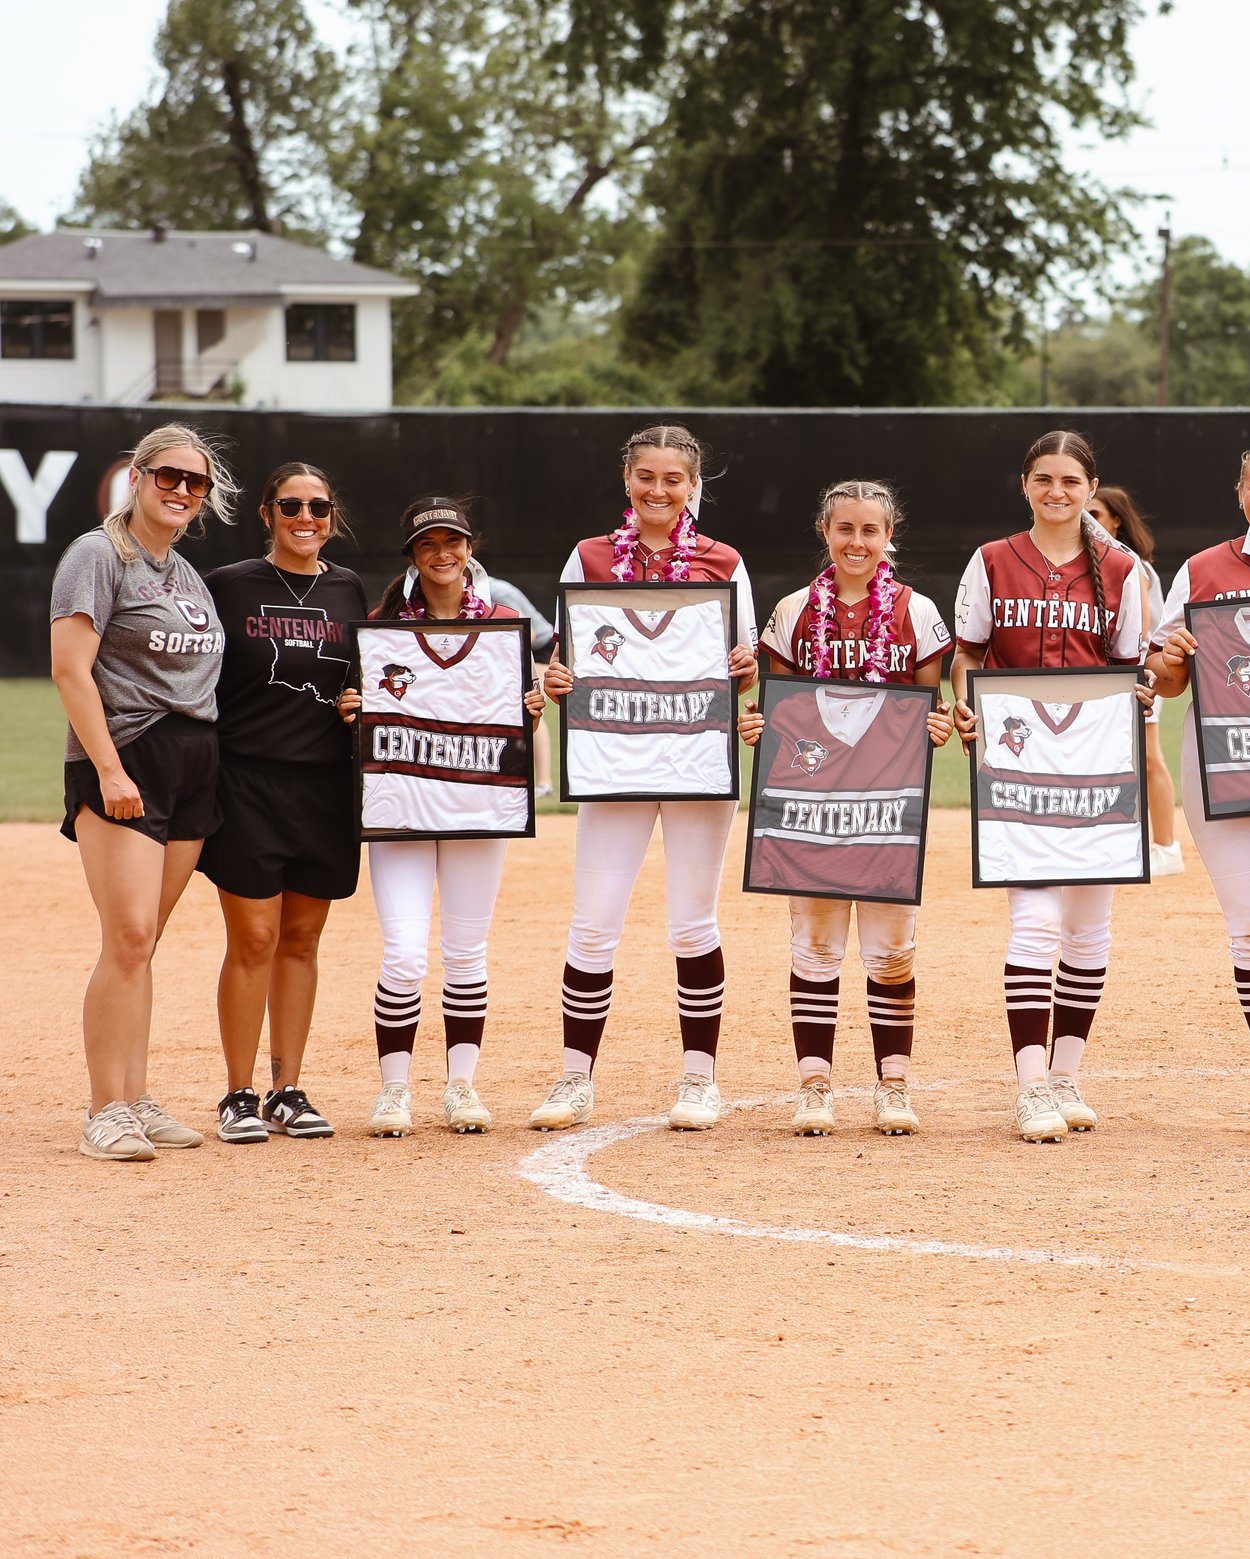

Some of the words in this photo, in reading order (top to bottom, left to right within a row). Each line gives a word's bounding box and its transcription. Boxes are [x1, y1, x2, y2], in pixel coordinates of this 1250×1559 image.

[0, 449, 78, 544] Y
[246, 616, 343, 643] CENTENARY
[284, 639, 314, 648] SOFTBALL
[797, 638, 912, 672] CETENRY
[589, 688, 715, 724] CENTENARY
[373, 725, 507, 772] CENTENARY
[989, 781, 1121, 818] CENTENARY
[781, 800, 907, 836] CENTENARY
